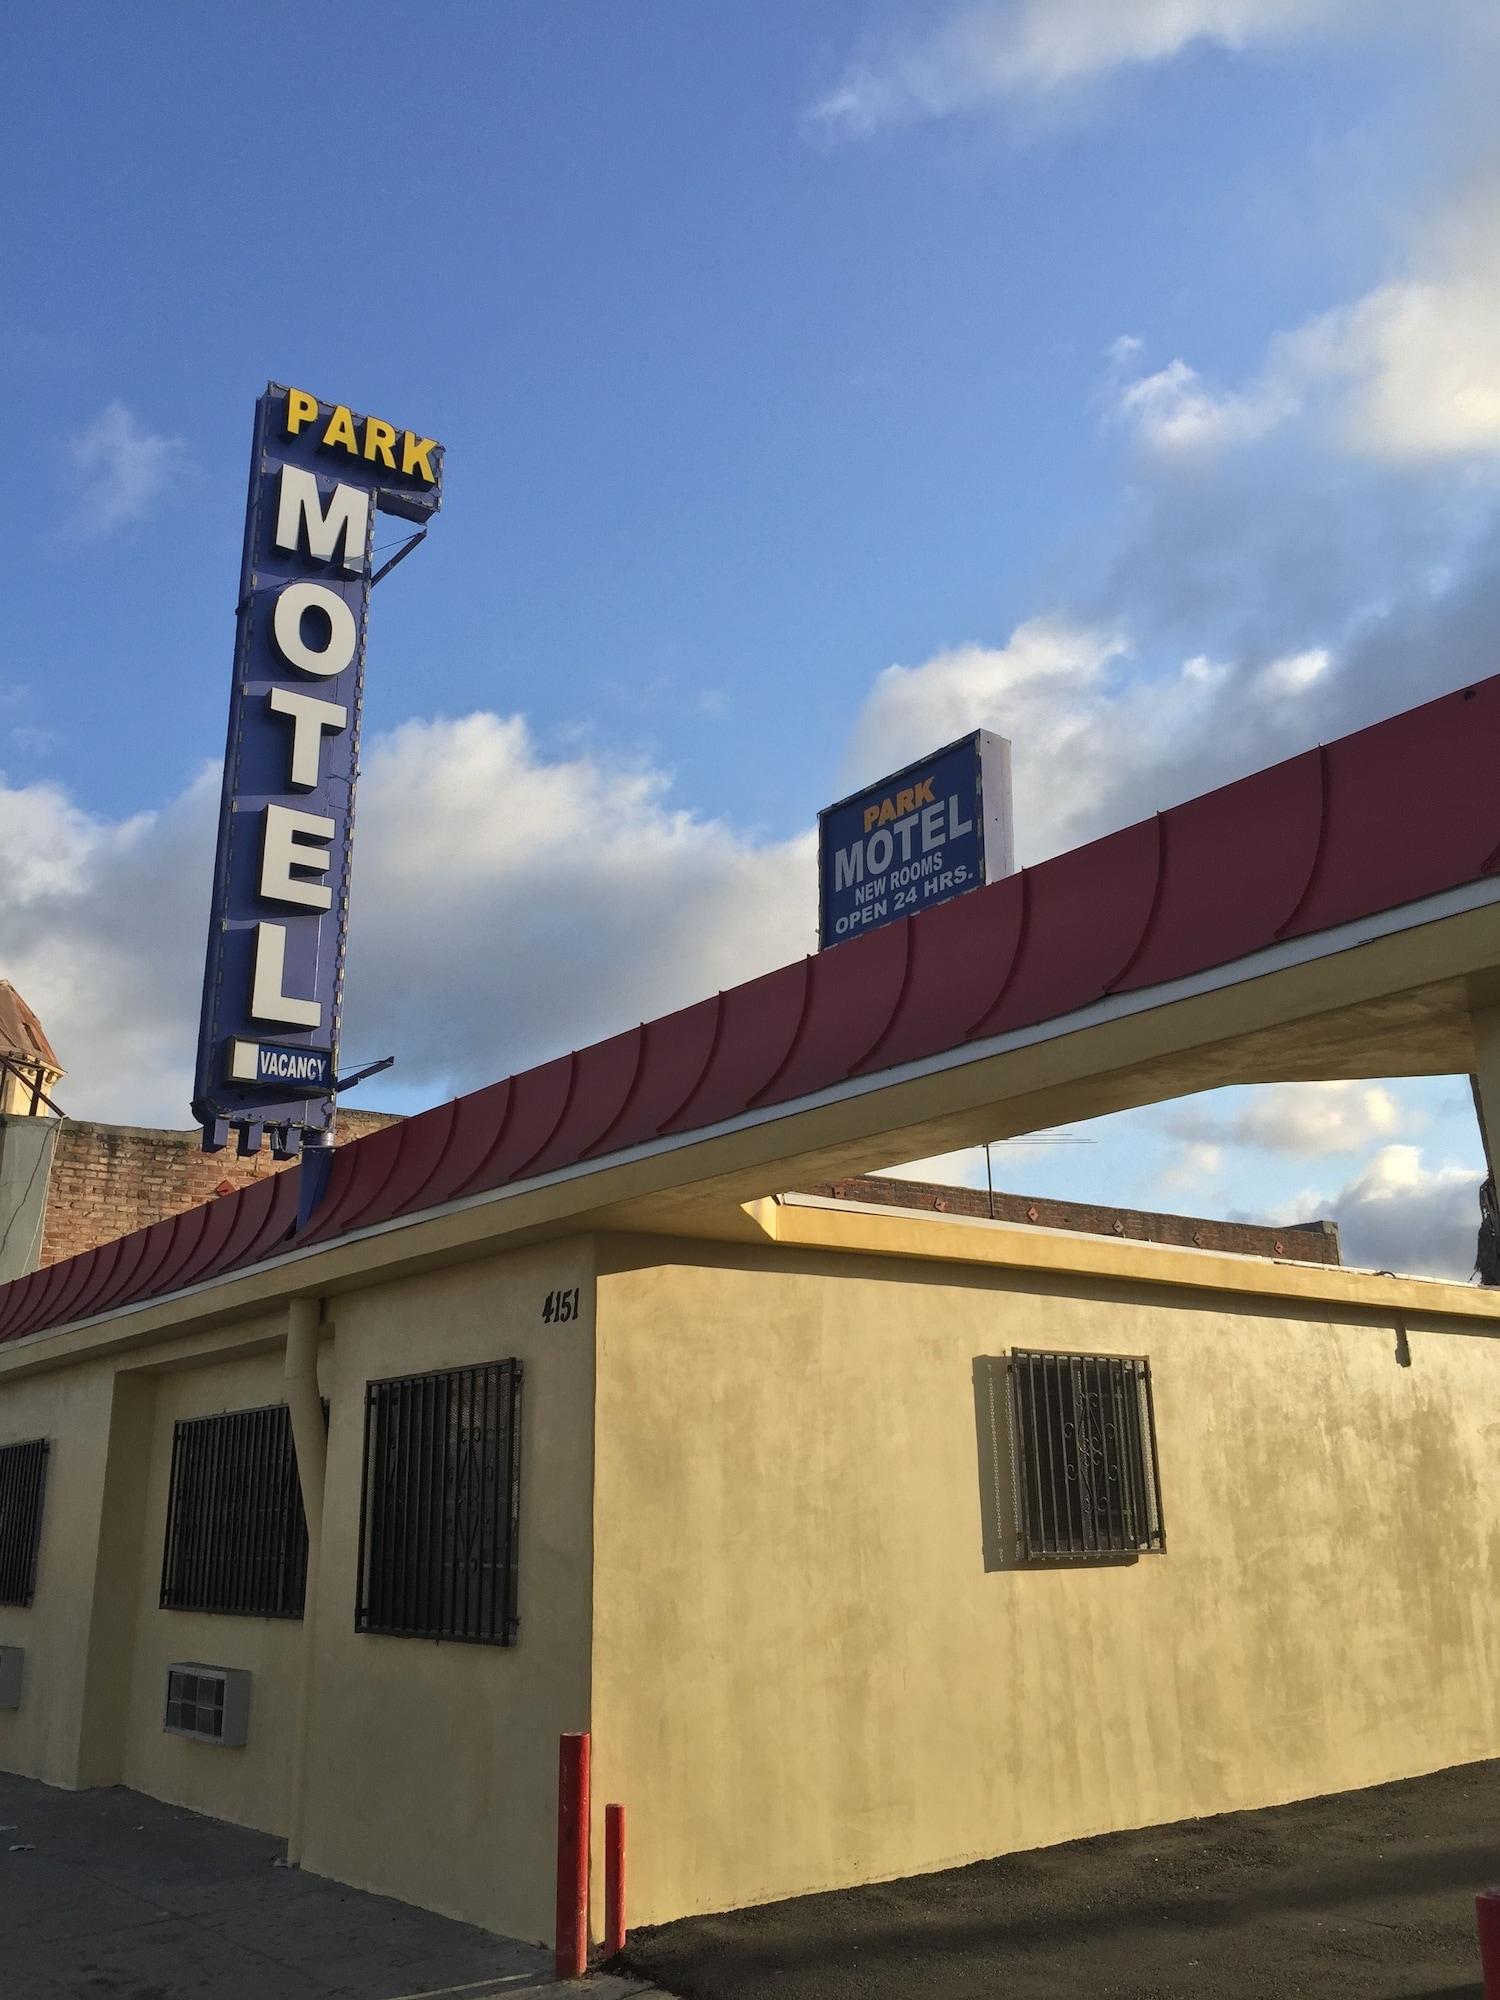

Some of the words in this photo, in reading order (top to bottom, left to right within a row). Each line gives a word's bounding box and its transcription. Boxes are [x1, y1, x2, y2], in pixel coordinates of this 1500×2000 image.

[286, 387, 437, 484] PARK
[251, 463, 370, 1029] MOTEL
[863, 776, 936, 833] PARK
[835, 794, 973, 893] MOTEL
[835, 900, 888, 935] OPEN
[893, 886, 918, 912] 24
[924, 864, 974, 899] HRS.
[855, 877, 887, 907] NEW
[890, 851, 943, 890] ROOMS
[260, 1049, 327, 1083] VACANCY
[542, 1287, 580, 1324] 4151
